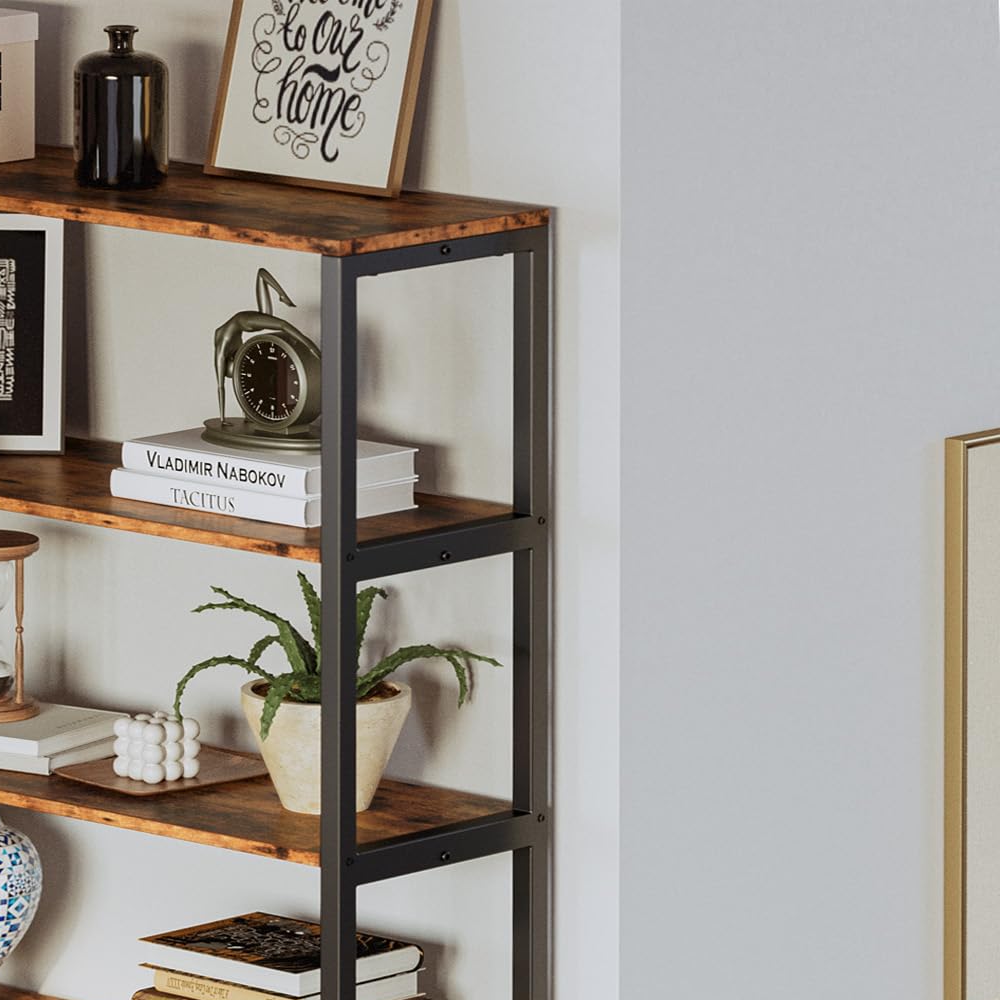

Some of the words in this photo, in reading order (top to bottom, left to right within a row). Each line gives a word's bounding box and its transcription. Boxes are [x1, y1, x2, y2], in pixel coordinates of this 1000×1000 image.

[277, 3, 307, 52] to
[276, 55, 366, 163] home
[146, 450, 213, 477] VLADIMIR
[216, 462, 286, 489] NABOKOV
[170, 487, 236, 513] TACITUS
